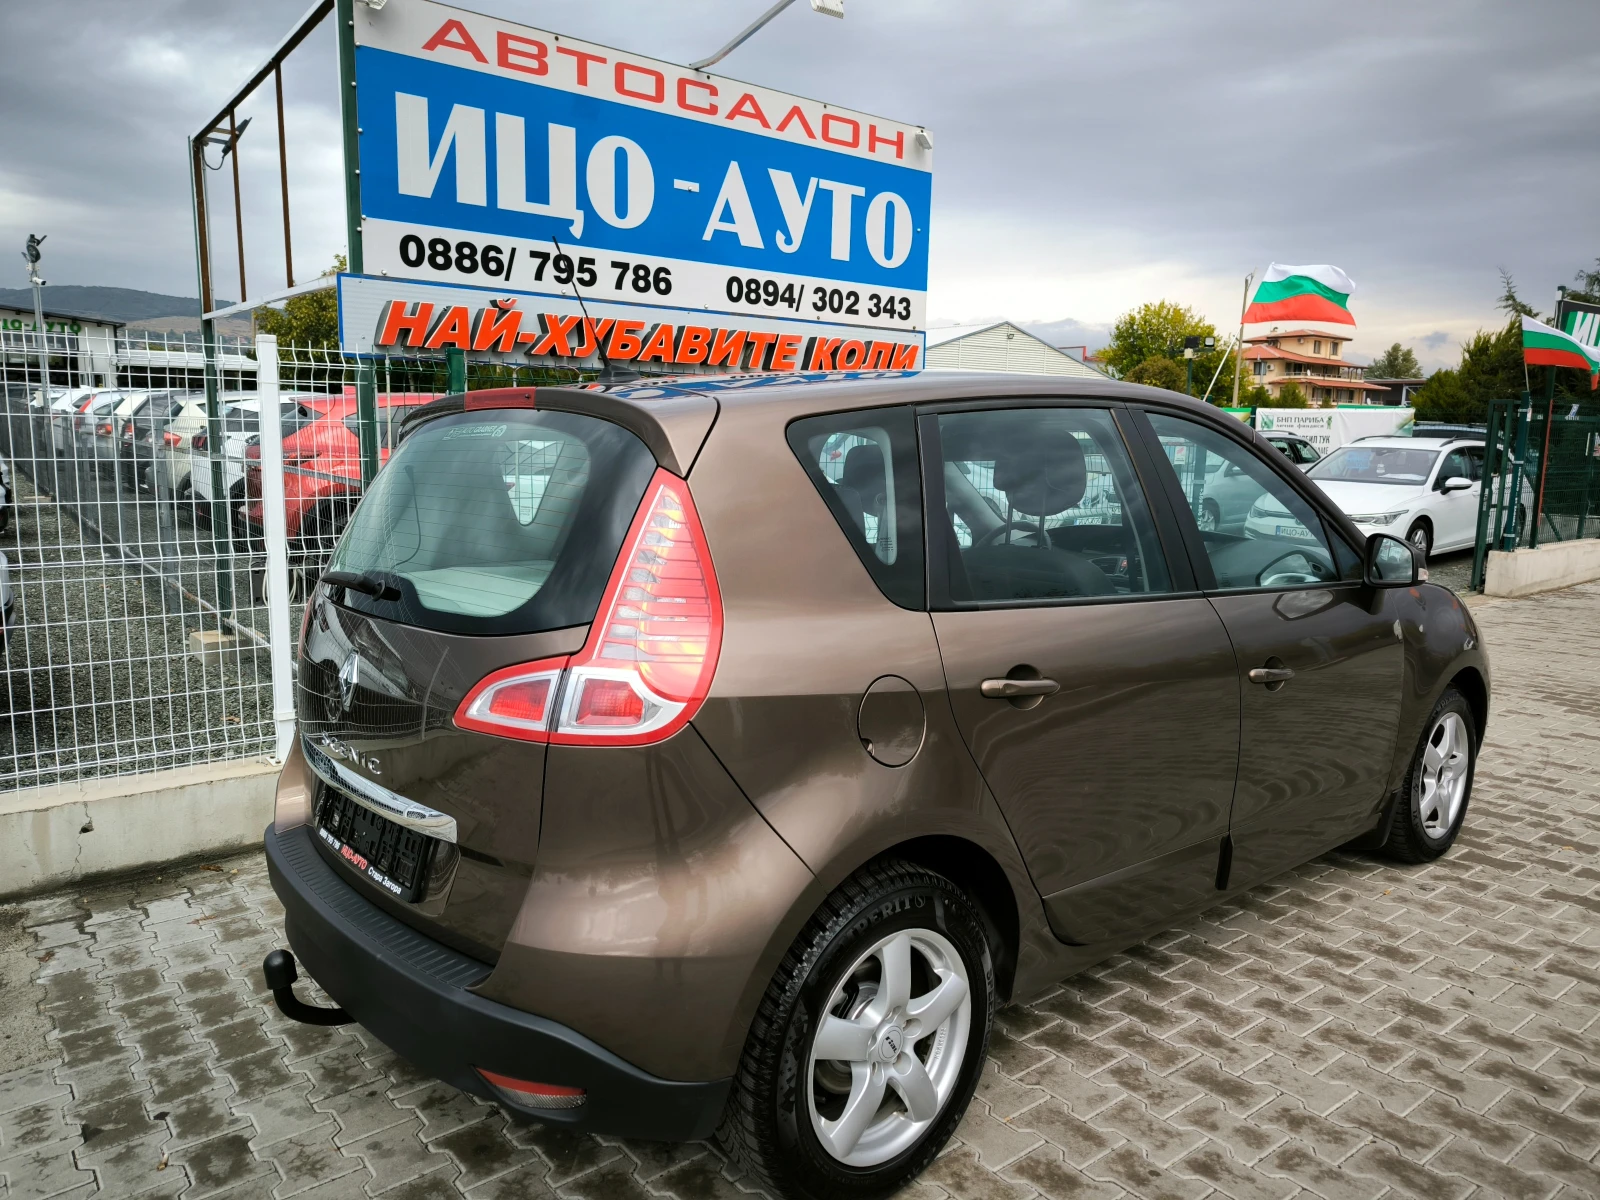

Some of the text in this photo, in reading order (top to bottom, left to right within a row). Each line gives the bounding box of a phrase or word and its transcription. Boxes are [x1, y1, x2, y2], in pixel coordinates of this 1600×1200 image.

[422, 18, 905, 159] АВТОСАЛОН
[399, 234, 911, 321] 0886/ 795 786 0894/ 302 343
[377, 297, 919, 371] НАЙ-ХУБАВИТЕ КОЛИ
[1294, 416, 1325, 424] ПАРИБА
[321, 731, 382, 775] SCENIC
[367, 866, 383, 883] Стара
[382, 876, 402, 895] Загора
